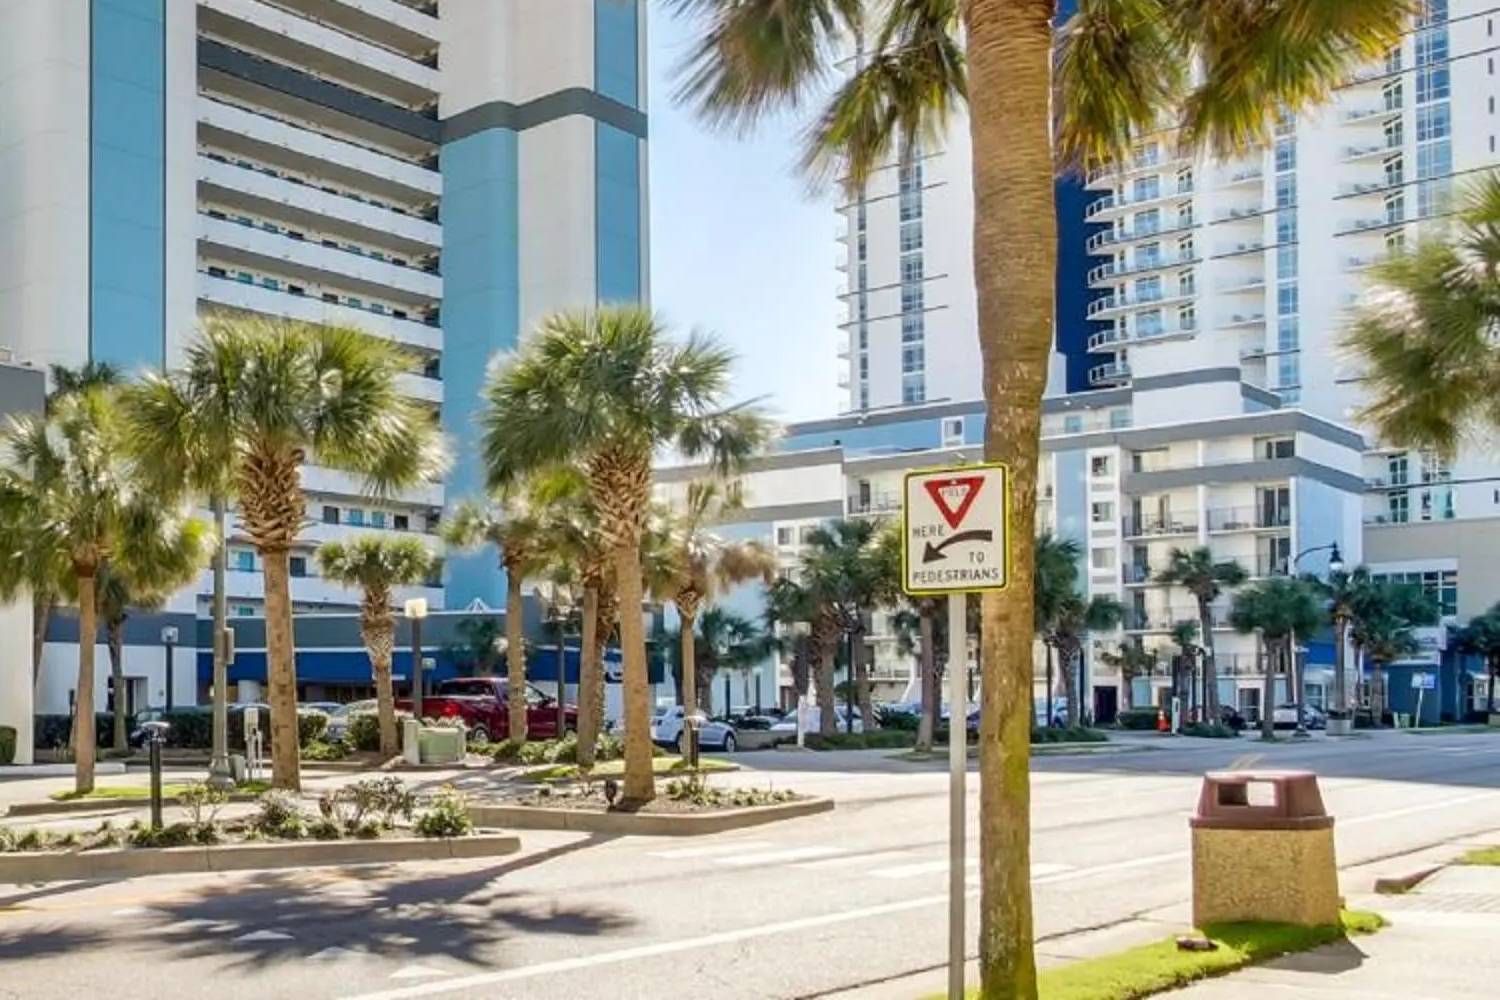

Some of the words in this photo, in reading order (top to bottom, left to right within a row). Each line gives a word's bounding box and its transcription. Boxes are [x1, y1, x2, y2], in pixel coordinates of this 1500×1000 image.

[912, 523, 945, 538] HERE
[969, 551, 985, 565] TO
[912, 568, 999, 584] PEDESTRIANS
